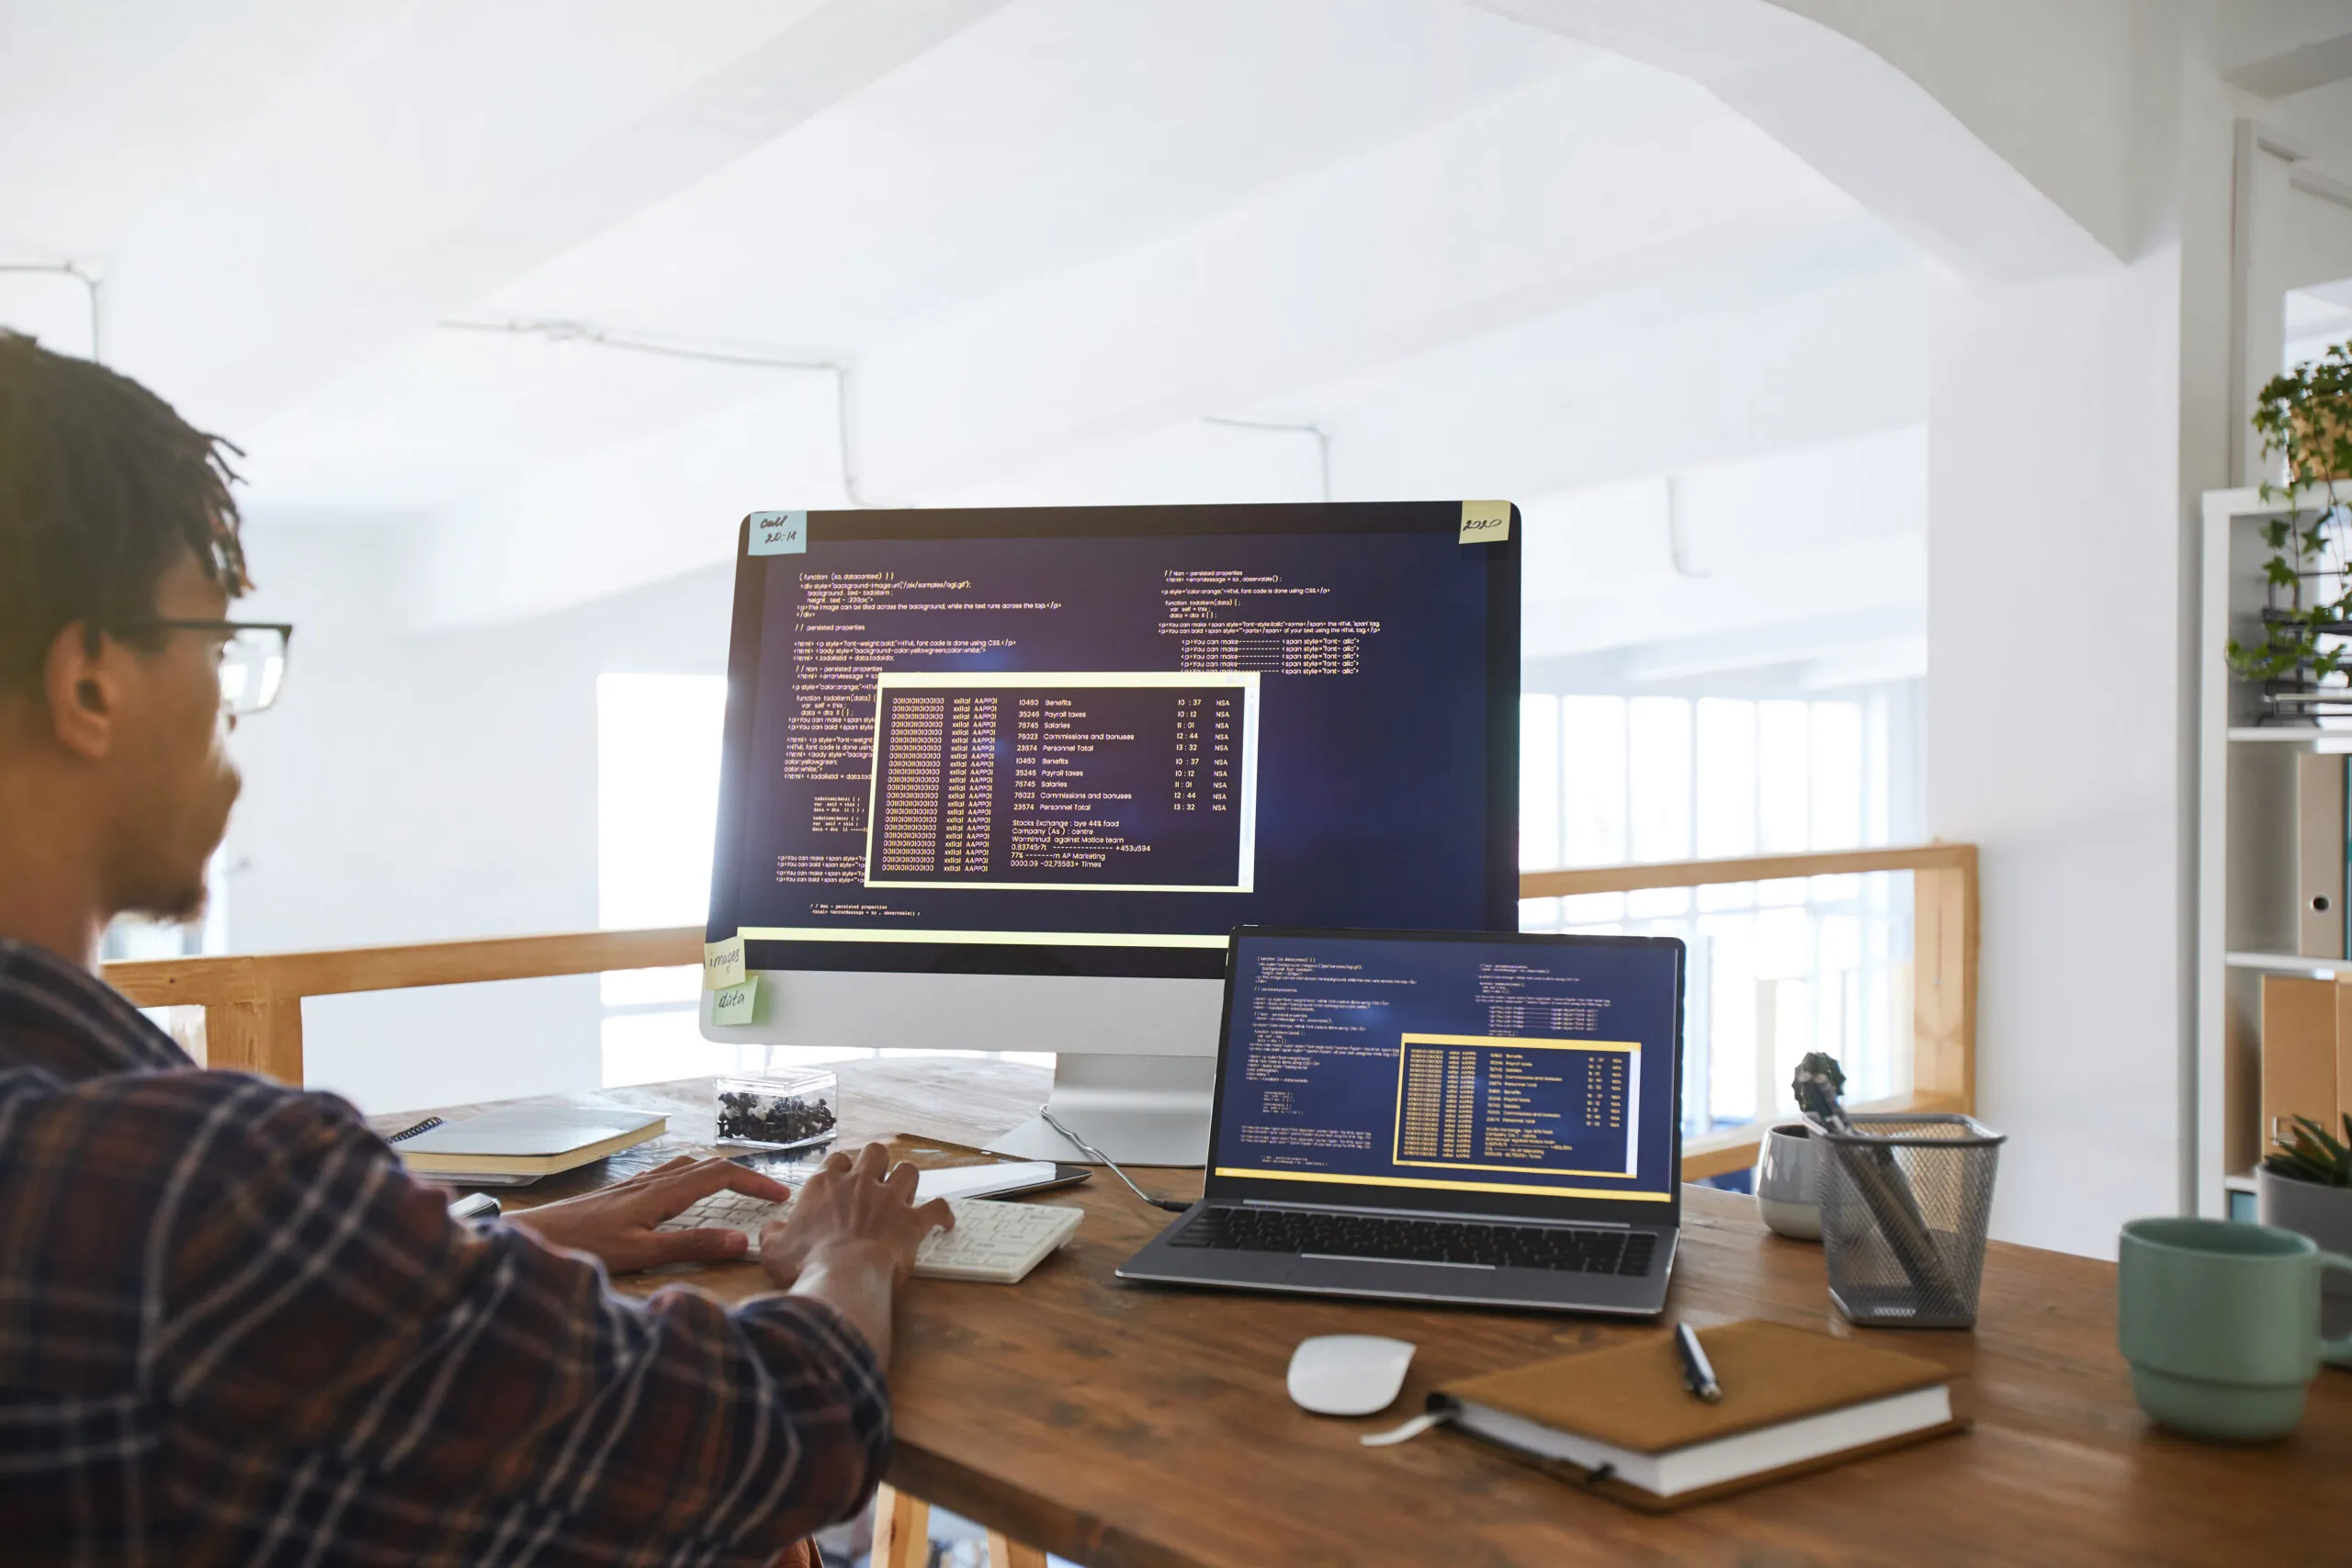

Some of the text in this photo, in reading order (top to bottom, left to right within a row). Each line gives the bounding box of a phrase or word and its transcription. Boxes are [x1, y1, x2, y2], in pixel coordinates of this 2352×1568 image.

[1044, 711, 1067, 719] Payroll
[1041, 770, 1064, 778] Payroll
[1035, 819, 1069, 829] Exchange
[1012, 828, 1046, 836] Company
[1054, 837, 1080, 845] against
[1072, 852, 1106, 861] Marketing
[709, 948, 740, 975] images
[718, 989, 745, 1009] data
